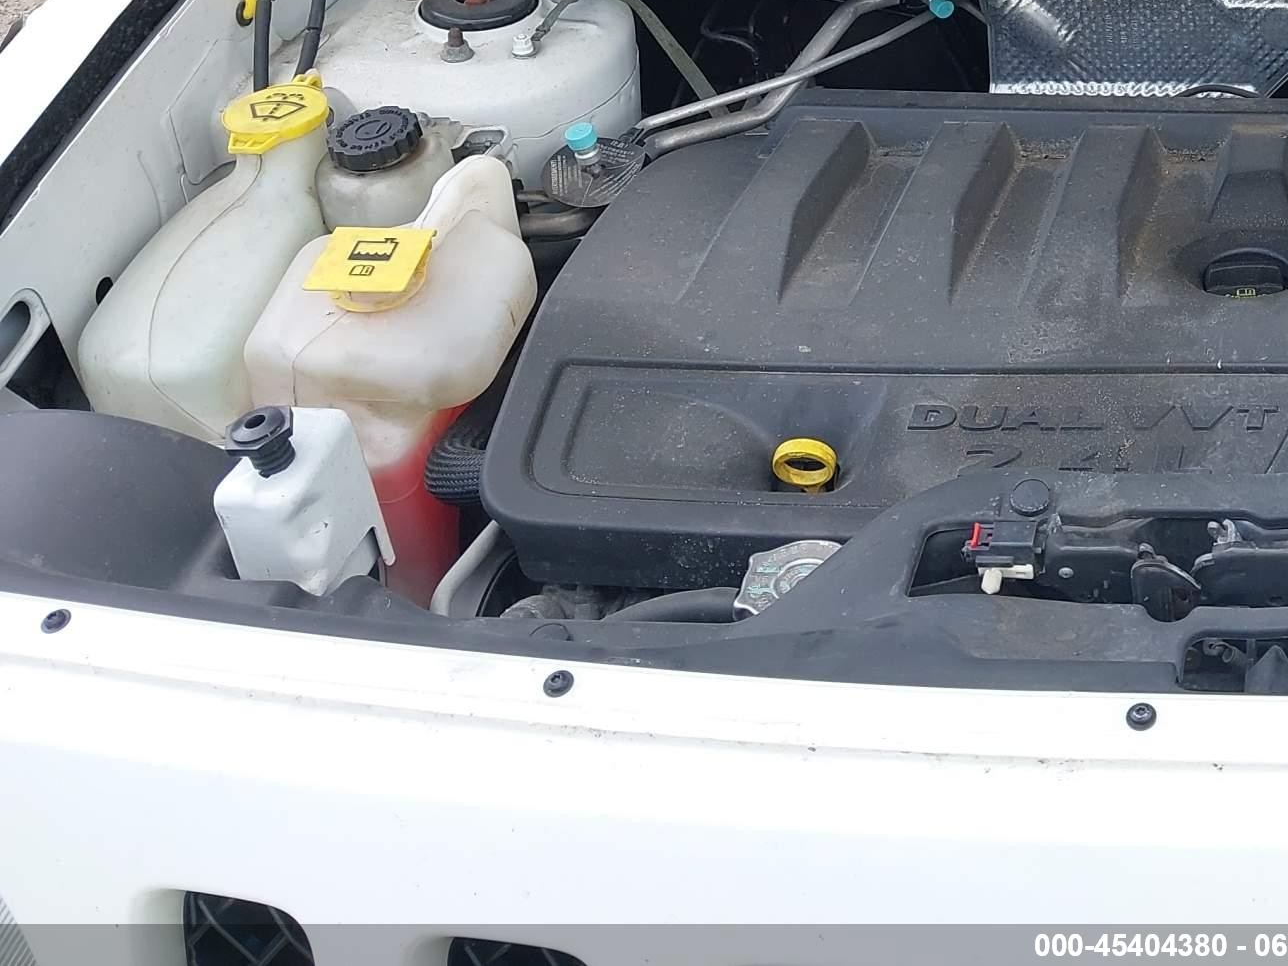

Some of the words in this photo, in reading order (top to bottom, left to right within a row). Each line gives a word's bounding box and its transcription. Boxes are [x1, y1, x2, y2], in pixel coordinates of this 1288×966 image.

[906, 404, 1105, 432] DUAL
[1125, 404, 1280, 432] VVT
[957, 444, 1213, 477] 24L
